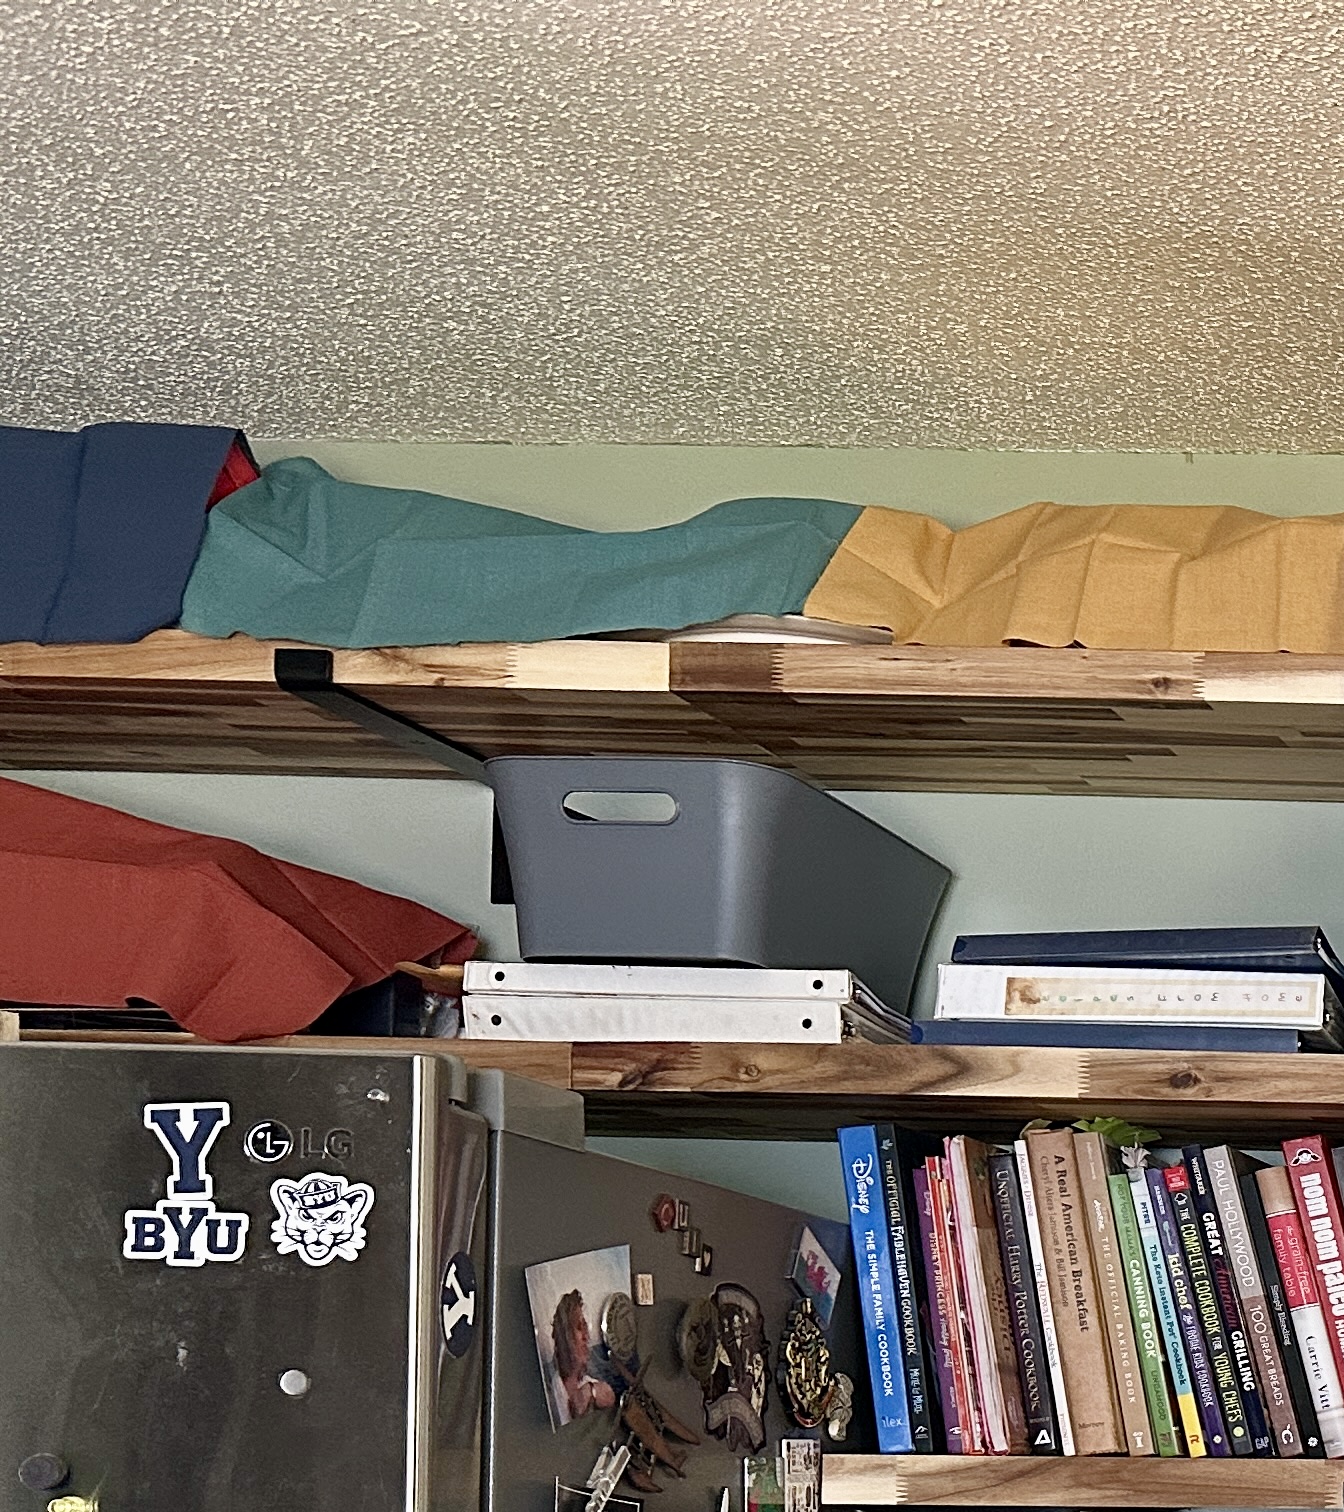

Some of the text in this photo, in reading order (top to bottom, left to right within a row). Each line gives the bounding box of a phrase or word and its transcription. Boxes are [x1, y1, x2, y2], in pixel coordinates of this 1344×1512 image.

[150, 1108, 224, 1194] Y
[300, 1127, 355, 1159] LG
[886, 1175, 902, 1226] OFFICIAL
[1179, 1207, 1191, 1222] THE
[1212, 1159, 1255, 1289] PAUL HOLLYWOOD
[1299, 1172, 1329, 1218] nom
[131, 1206, 242, 1260] BYU
[1053, 1248, 1063, 1256] &
[1054, 1154, 1091, 1333] A Real American Breakfast
[1181, 1222, 1208, 1279] COMPLETE
[1272, 1227, 1299, 1297] family table
[1310, 1216, 1340, 1262] nom
[890, 1226, 912, 1299] FABLEHAVEN
[993, 1169, 1018, 1240] UNOFFICIAL
[1006, 1245, 1025, 1287] HARRY
[1020, 1338, 1043, 1412] COOKBOOK
[1167, 1252, 1185, 1278] kid
[1287, 1236, 1313, 1295] grain-free
[863, 1230, 894, 1397] THE SIMPLE FAMILY COOKBOOK
[1101, 1236, 1137, 1404] THE OFFICIAL BAKING BOOK
[1128, 1258, 1151, 1318] CANNING
[1140, 1321, 1159, 1359] BOOK
[1149, 1244, 1188, 1386] The Keto Instant Cookbook
[1174, 1278, 1193, 1312] chef
[1193, 1279, 1221, 1336] COOKBOOK
[1202, 1211, 1223, 1257] GREAT
[1230, 1329, 1255, 1392] GRILLING
[900, 1298, 918, 1355] COOKBOOK
[1248, 1304, 1284, 1407] 100 GREAT BREADS
[1212, 1351, 1236, 1390] YOUNG
[1304, 1335, 1332, 1410] Carrie Vitt
[1222, 1388, 1244, 1423] CHEFS
